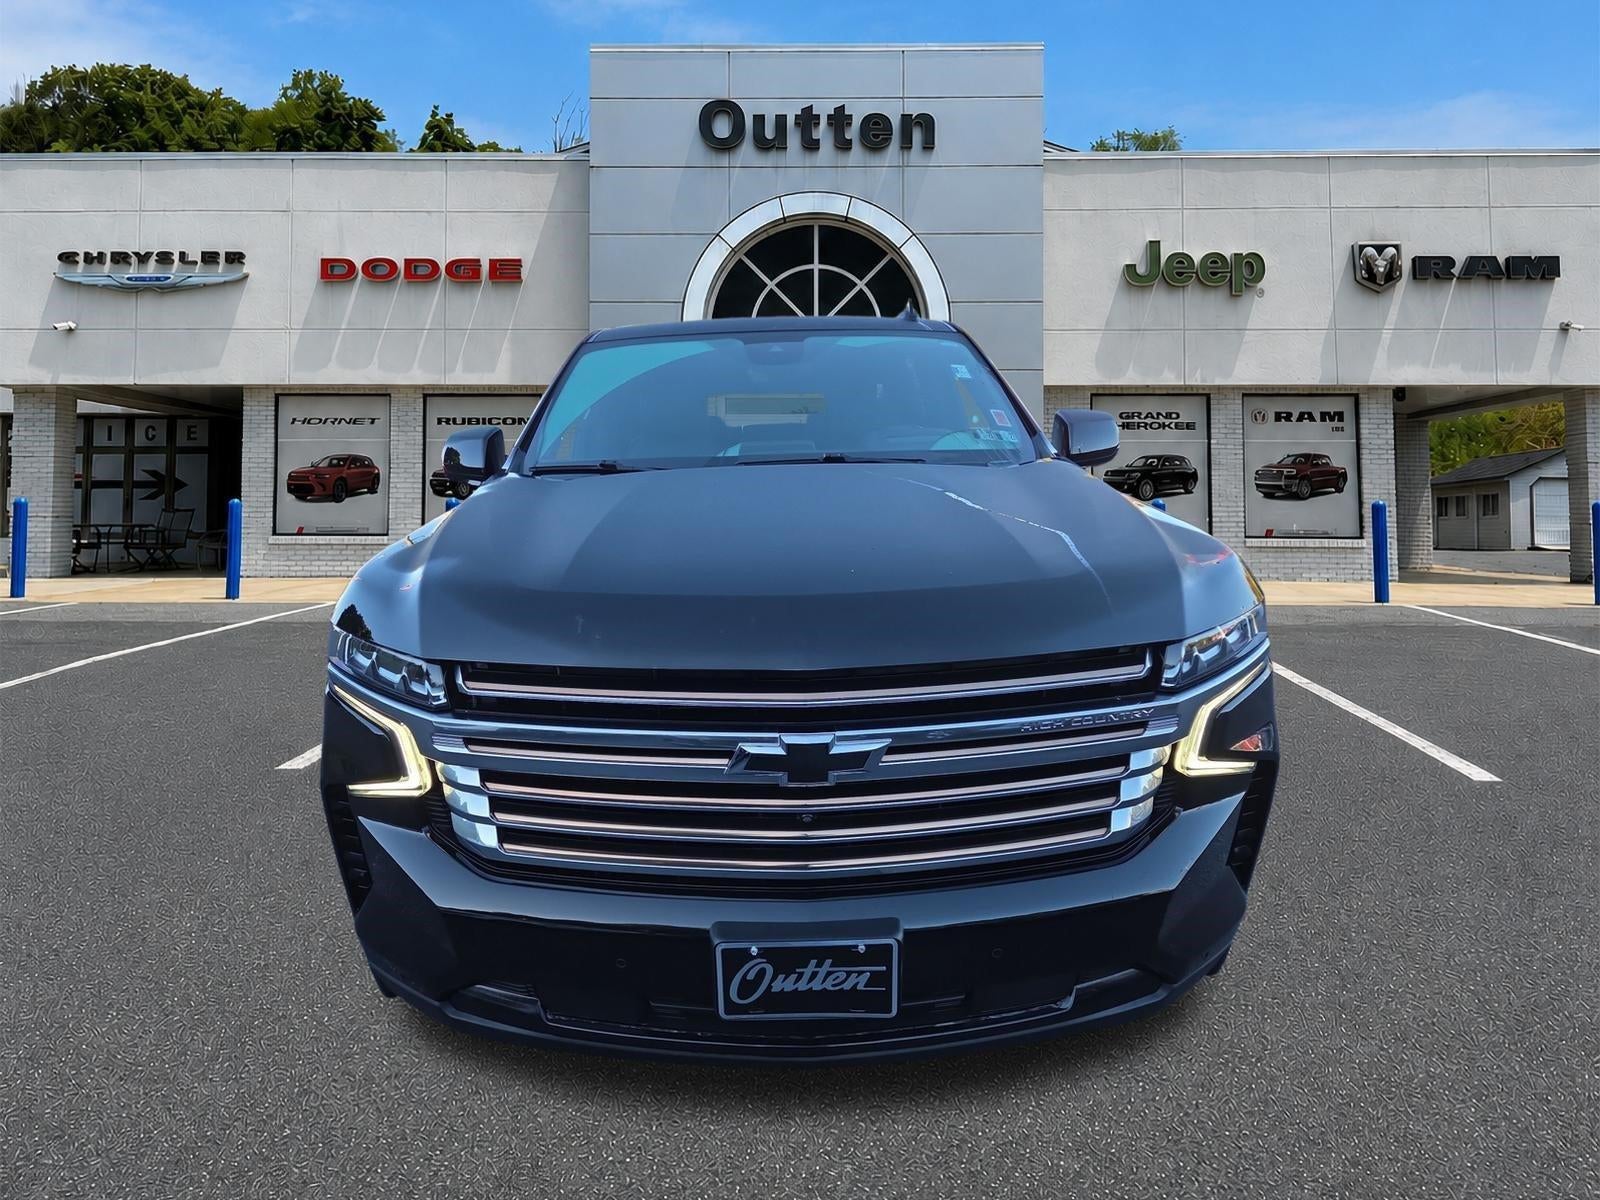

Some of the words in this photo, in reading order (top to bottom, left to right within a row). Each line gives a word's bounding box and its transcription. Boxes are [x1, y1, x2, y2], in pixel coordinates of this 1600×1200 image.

[699, 99, 935, 149] Outten
[57, 251, 247, 265] CHRYSLER
[320, 257, 523, 282] DODGE
[1124, 240, 1266, 296] Jeep
[1411, 255, 1561, 280] RAM
[290, 417, 381, 425] HORNET
[1118, 411, 1180, 420] GRAND
[1274, 411, 1345, 422] RAM
[1020, 720, 1065, 732] HIGH
[1071, 708, 1155, 726] COUNTRY
[729, 958, 887, 1005] Outten
